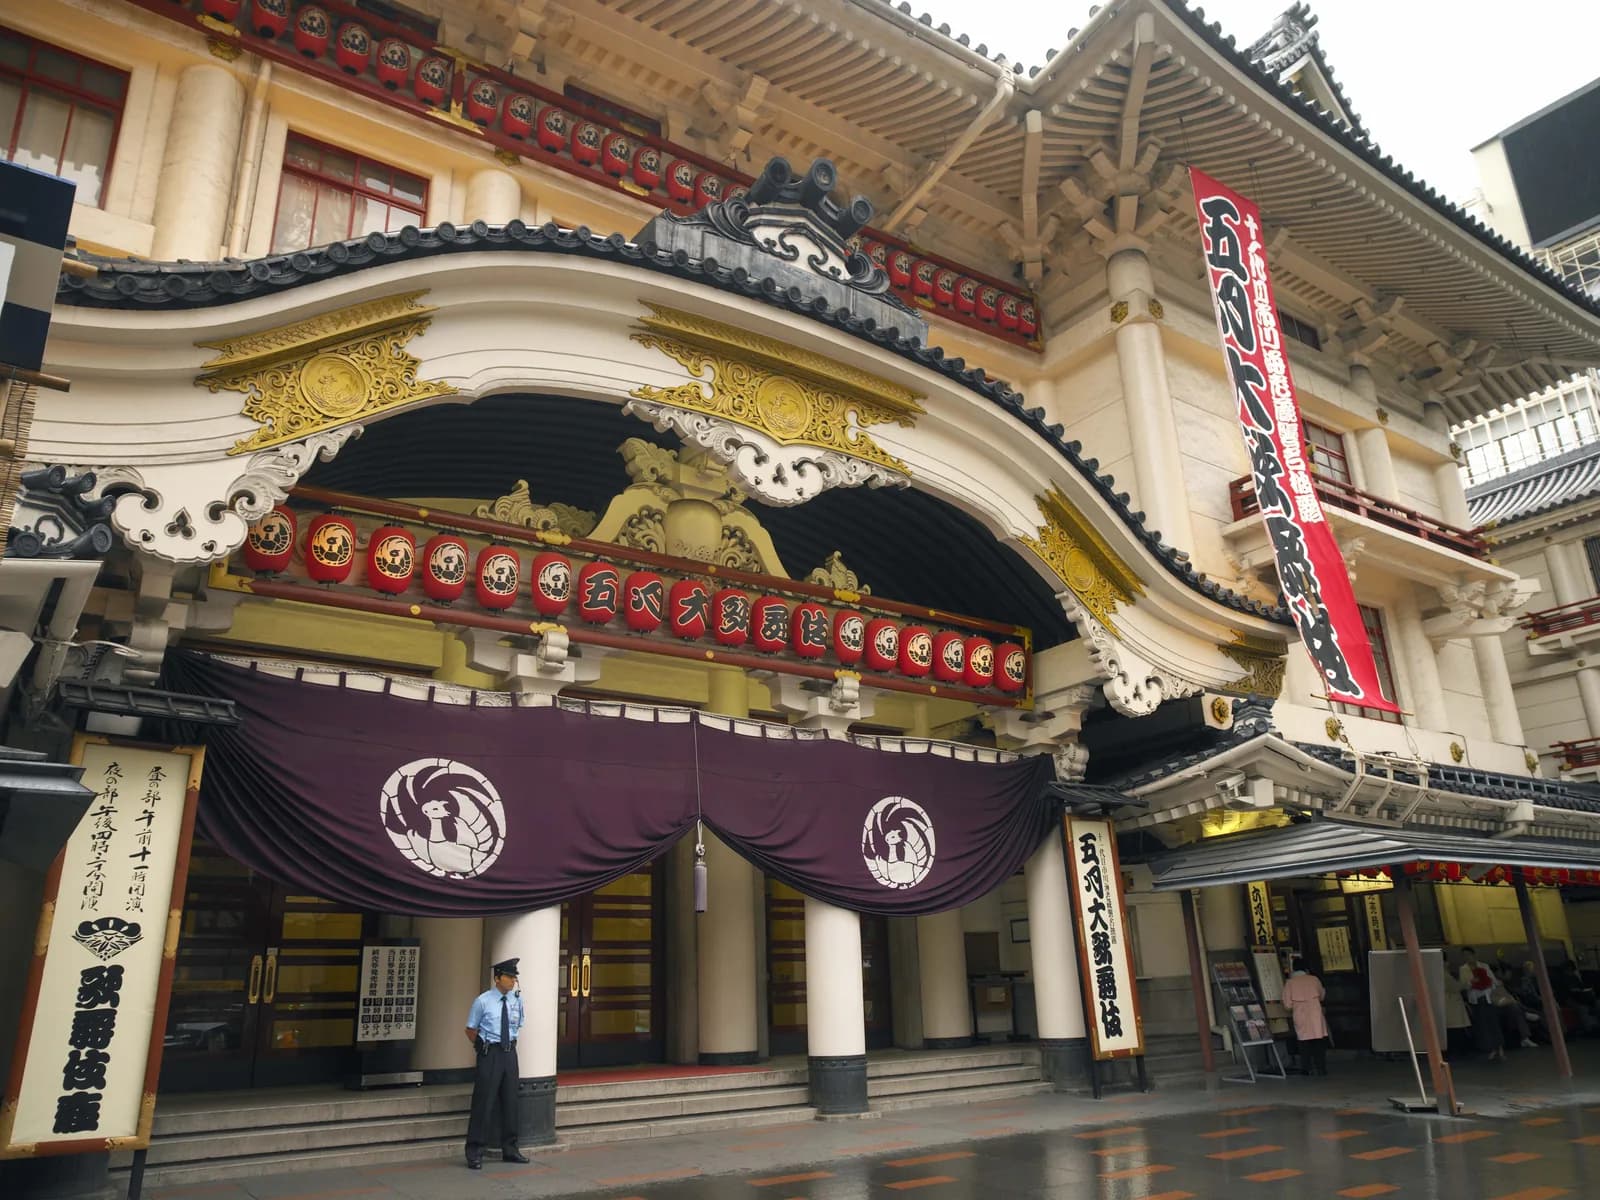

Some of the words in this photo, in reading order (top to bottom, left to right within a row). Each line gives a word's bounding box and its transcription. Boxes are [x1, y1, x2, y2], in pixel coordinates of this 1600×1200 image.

[1079, 832, 1123, 1039] 五月大歌舞伎
[53, 965, 124, 1133] 歌舞伎座
